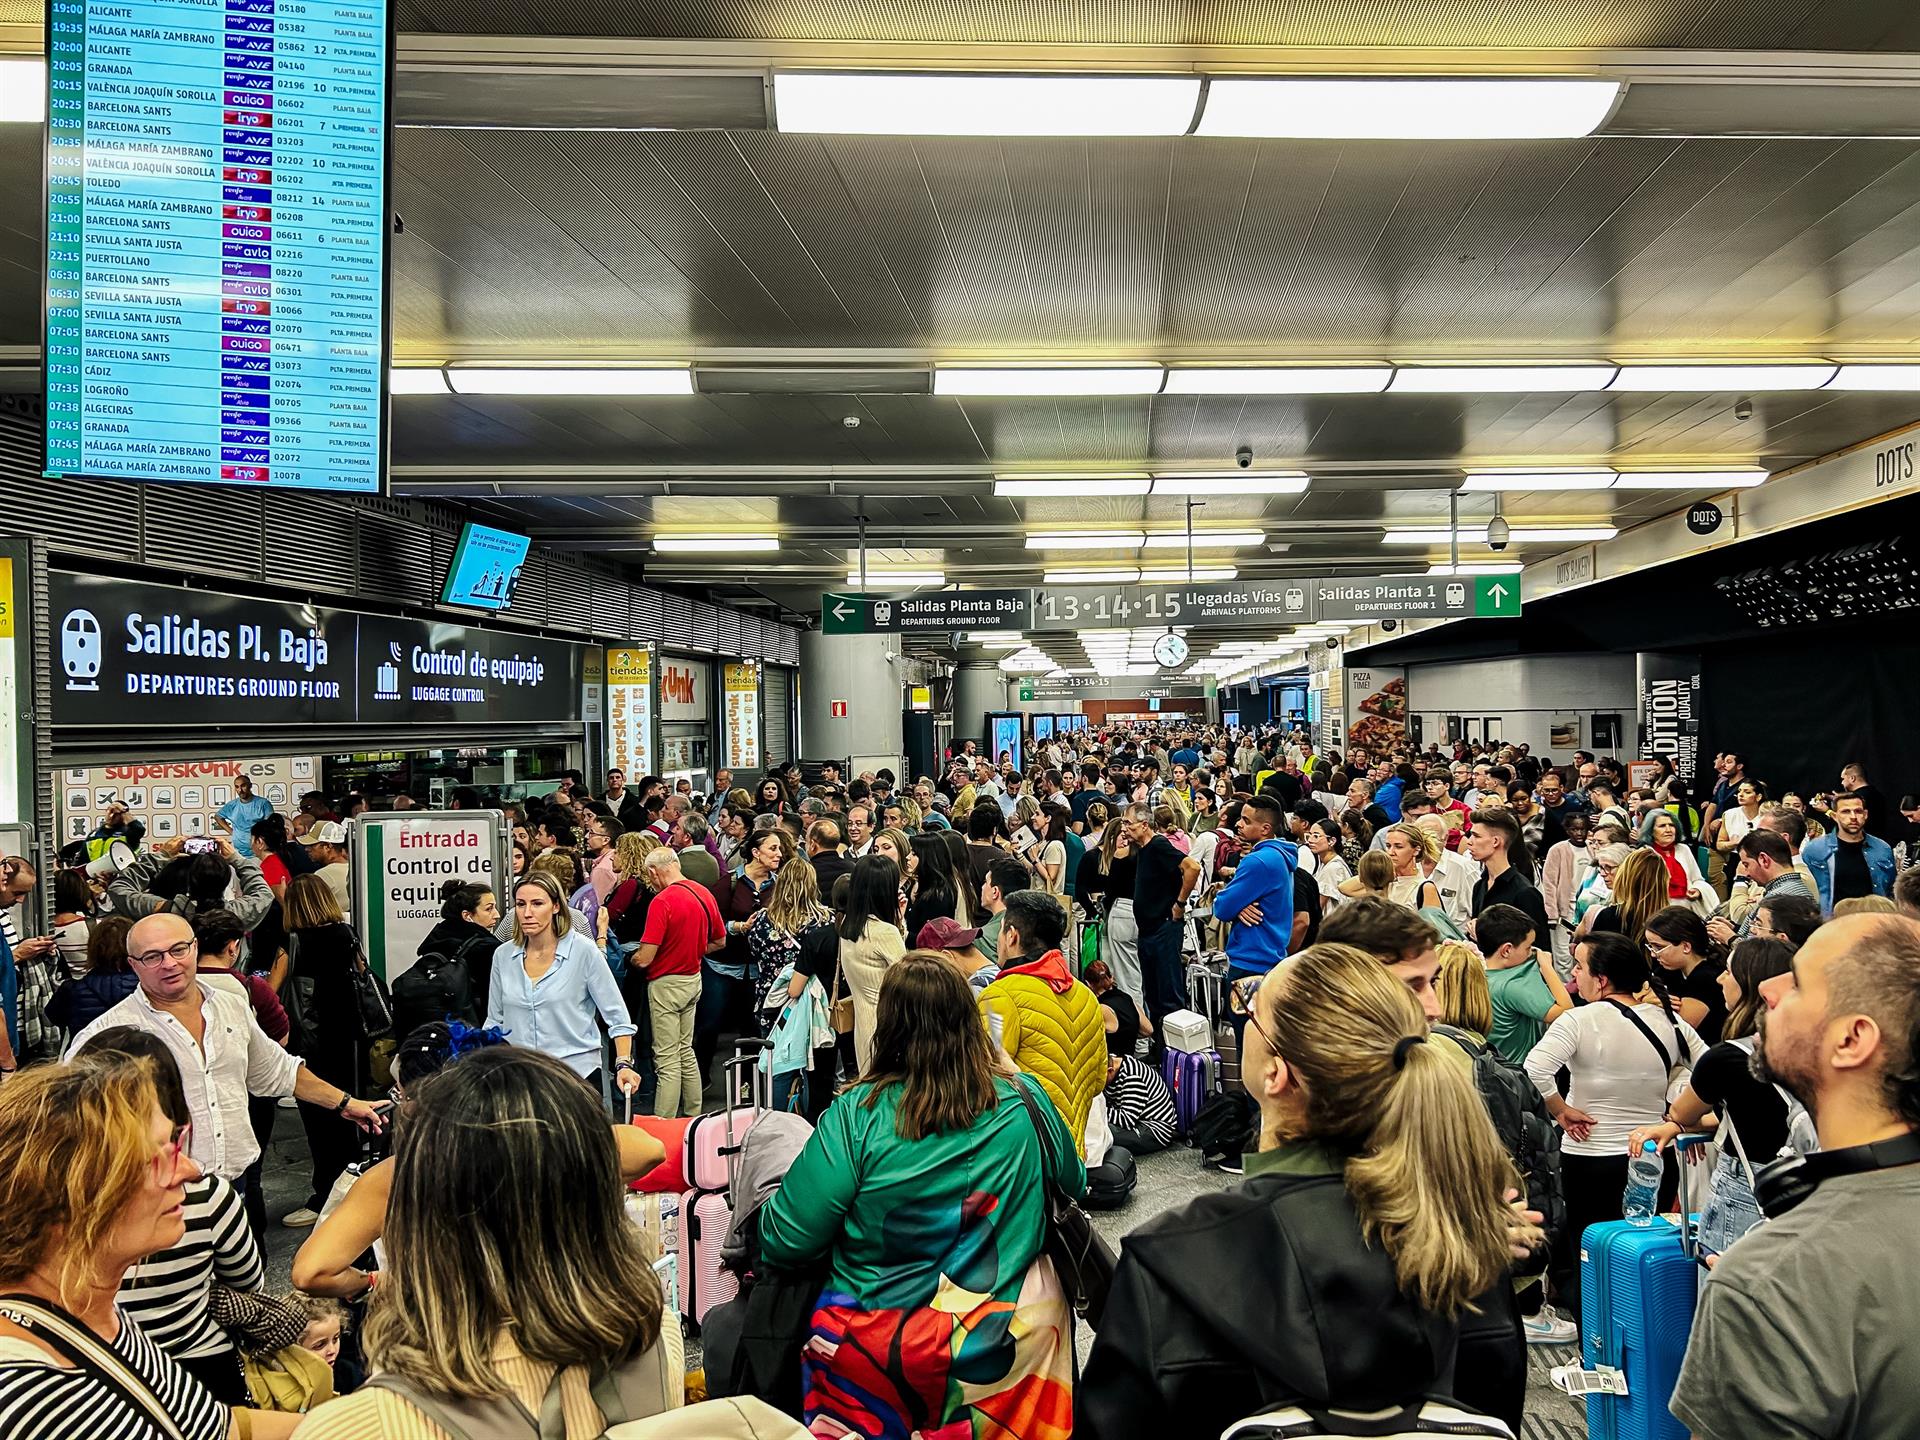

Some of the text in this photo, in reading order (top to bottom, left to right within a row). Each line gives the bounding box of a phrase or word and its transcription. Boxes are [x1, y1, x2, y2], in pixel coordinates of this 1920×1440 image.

[53, 3, 305, 32] 19:00 ALICANTE 05382
[52, 22, 305, 51] 19:35 MÁLAGA MARÍA ZAMBRANO 05862
[52, 41, 131, 56] 20:00 ALICANTE
[52, 60, 304, 89] 20:05 GRANADA 02196
[52, 80, 304, 108] 20:15 VALÈNCIA JOAQUÍN SOROLLA 06602
[52, 99, 304, 127] 20:25 BARCELONA SANTS 06201
[52, 118, 303, 146] 20:30 BARCELONA SANTS 03203
[51, 137, 303, 165] 20:35 MÁLAGA MARÍA ZAMBRANO 02202
[51, 156, 303, 184] 20:45 VALÈNCIA JOAQUÍN SOROLLA 06202
[51, 175, 121, 188] 20:45 TOLEDO
[51, 194, 303, 221] 20:55 MÁLAGA MARÍA ZAMBRANO 06208
[51, 213, 302, 240] 21:00 BARCELONA SANTS 06611
[51, 232, 182, 250] 21:10 SEVILLA SANTA JUSTA
[50, 251, 302, 278] 22:15 PUERTOLLANO 08220
[50, 270, 170, 286] 06:30 BARCELONA SANTS
[50, 288, 302, 315] 06:30 SEVILLA SANTA JUSTA 10066
[50, 307, 302, 333] 07:00 SEVILLA SANTA JUSTA 02070
[50, 326, 170, 343] 07:05 BARCELONA SANTS
[50, 345, 301, 370] 07:30 BARCELONA SANTS 03073
[49, 364, 301, 388] 07:30 CÁDIZ 02074
[49, 383, 129, 396] 07:35 LOGROÑO
[49, 401, 301, 425] 07:38 ALGECIRAS 09366
[49, 420, 301, 443] 07:45 GRANADA 02076
[49, 439, 300, 462] 07:45 MÁLAGA MARÍA ZAMBRANO 02072
[49, 457, 300, 480] 08:13 MÁLAGA MARÍA ZAMBRANO 10078
[1876, 443, 1913, 487] DOTS
[1692, 510, 1716, 522] DOTS
[1186, 588, 1281, 607] Llegadas Vías
[1318, 584, 1437, 601] Salidas Planta 1
[901, 597, 1024, 613] Salidas Planta Baja
[1200, 606, 1282, 616] ARRIVALS PLATFORMS
[1354, 602, 1403, 611] DEPARTURES
[1404, 601, 1429, 610] FLOOR
[900, 617, 945, 626] DEPARTURES
[126, 613, 328, 673] Salidas Pl. Baja
[412, 641, 544, 687] Control de equipaje
[610, 666, 648, 675] tiendas
[126, 673, 340, 699] DEPARTURES GROUND FLOOR
[1352, 672, 1371, 681] PIZZA
[412, 686, 485, 702] LUGGAGE CONTROL
[1678, 680, 1691, 720] QUALITY
[1679, 736, 1692, 778] PREMIUM
[400, 830, 479, 849] Entrada
[388, 856, 491, 875] Control de
[396, 908, 440, 919] LUGGAGE
